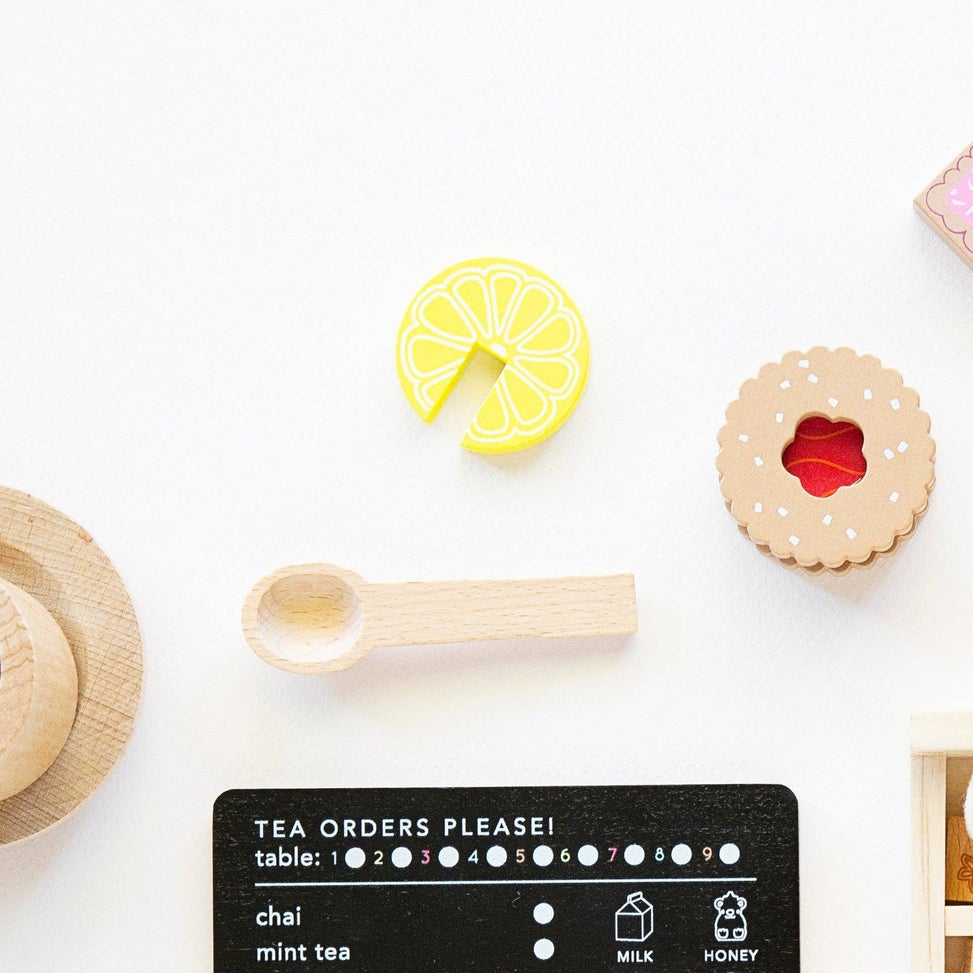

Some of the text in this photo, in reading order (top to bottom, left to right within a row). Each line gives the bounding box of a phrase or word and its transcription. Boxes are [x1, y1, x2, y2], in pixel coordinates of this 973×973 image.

[254, 816, 554, 839] TEA ORDERS PLEASE!
[254, 845, 713, 868] table: 1 2 3 4 5 6 7 8 9
[255, 904, 301, 927] chai
[256, 941, 351, 962] mint tea
[616, 949, 654, 963] MILK
[704, 948, 759, 963] HONEY
